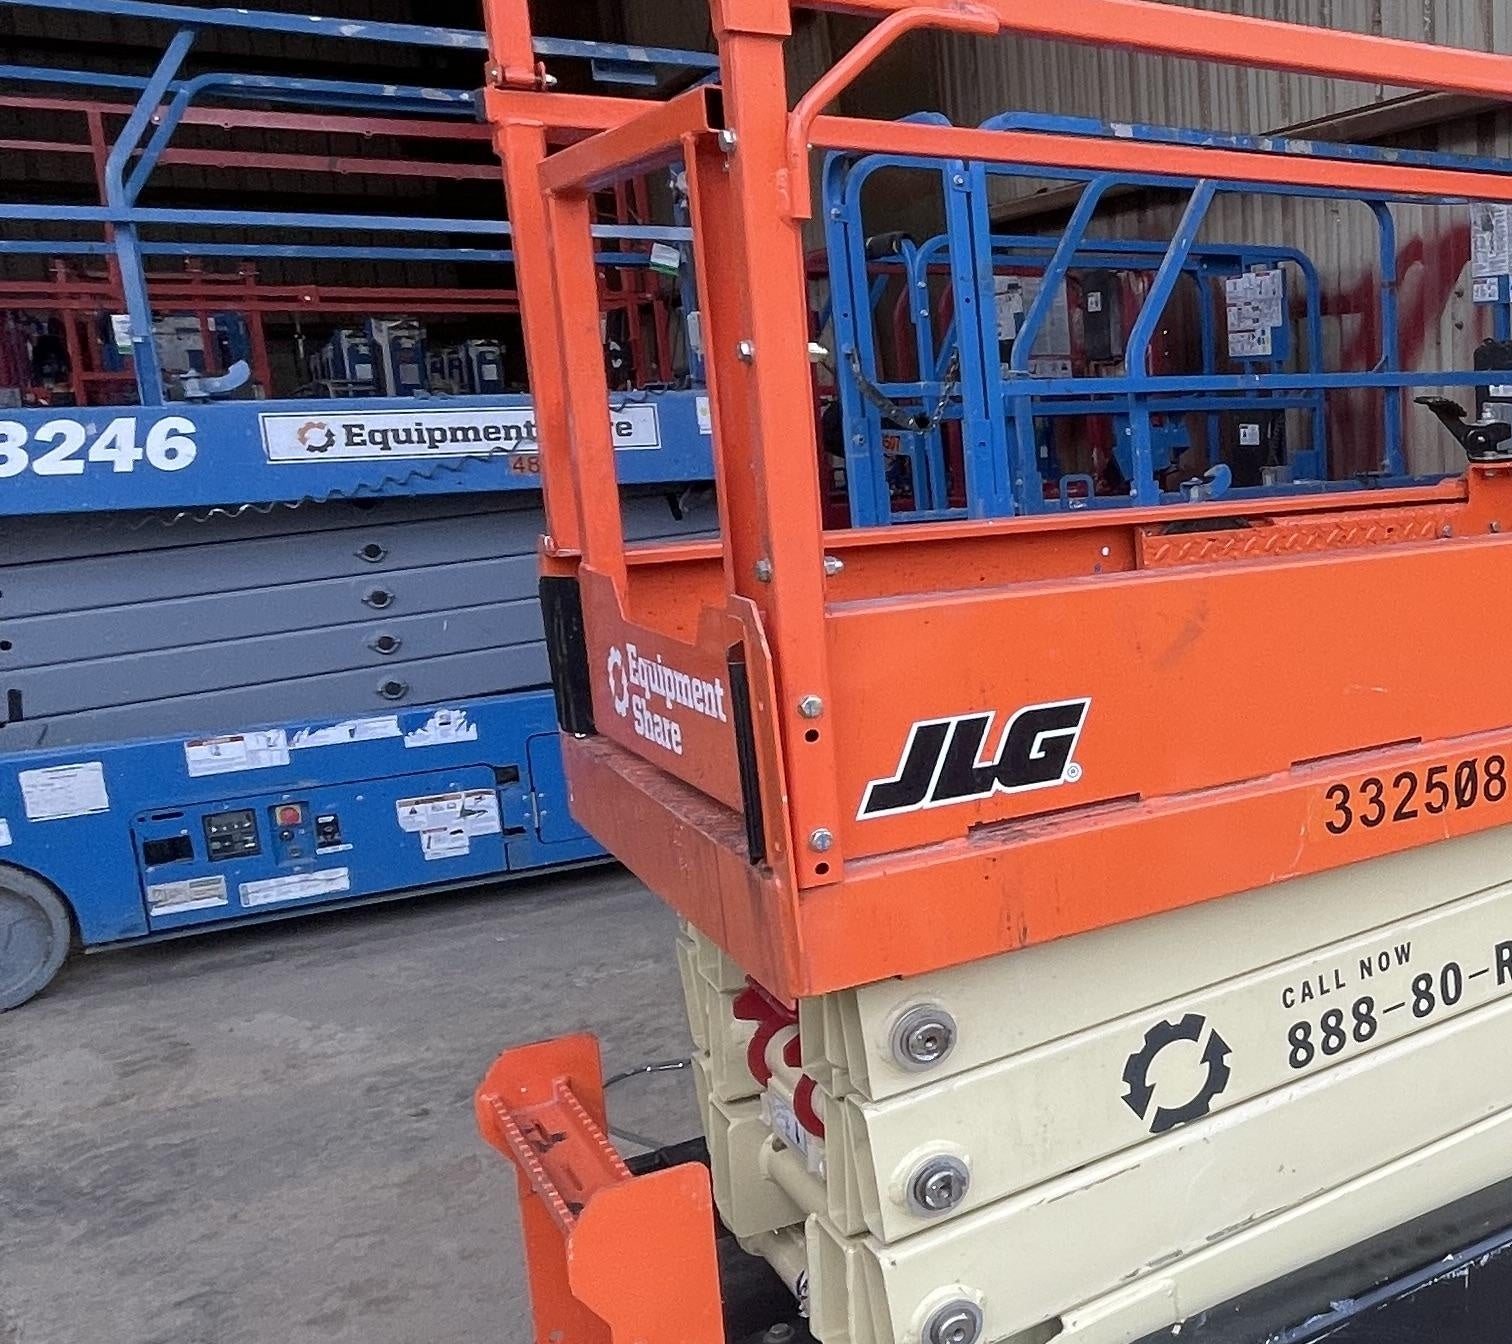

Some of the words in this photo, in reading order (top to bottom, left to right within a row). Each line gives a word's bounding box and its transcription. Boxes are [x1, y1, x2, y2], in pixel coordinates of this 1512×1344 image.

[625, 642, 727, 723] Equipment
[631, 693, 683, 756] Share
[860, 698, 1090, 819] JLG
[1324, 755, 1508, 835] 332508
[1281, 968, 1347, 1009] CALL
[1359, 941, 1413, 980] NOW
